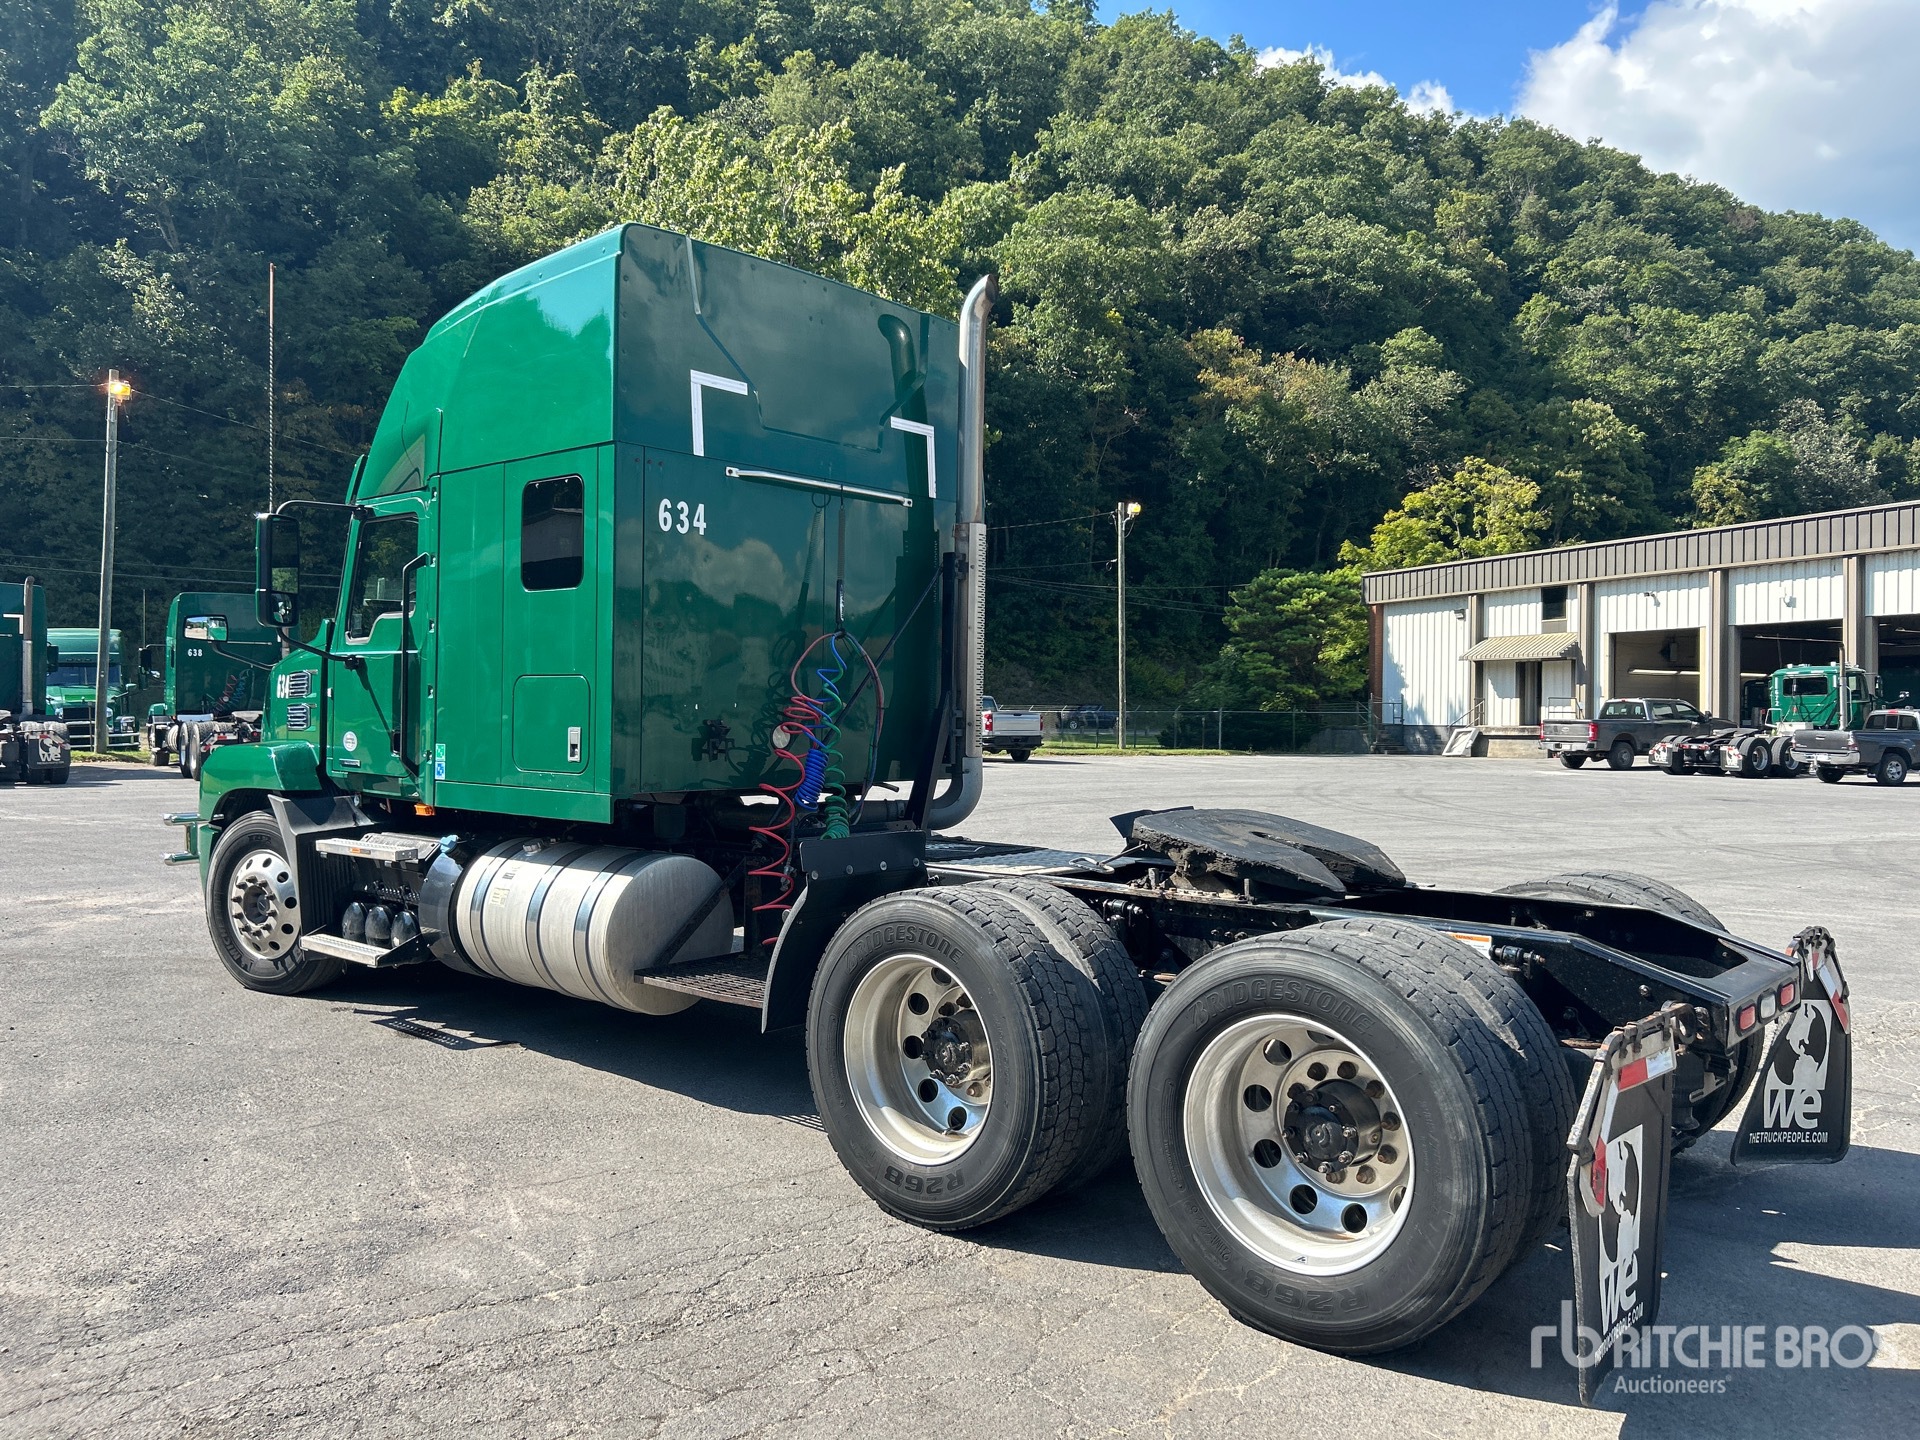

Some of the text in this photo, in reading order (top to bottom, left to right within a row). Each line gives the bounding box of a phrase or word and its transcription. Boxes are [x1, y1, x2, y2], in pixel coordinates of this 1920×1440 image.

[658, 498, 707, 536] 634
[187, 648, 203, 657] 638
[842, 924, 964, 976] BRIDGESTONE
[1187, 977, 1376, 1034] BRIDGESTONE
[1748, 1131, 1829, 1144] THETRUCKPEOPLE.COM
[884, 1166, 965, 1195] R268
[1243, 1269, 1368, 1314] R268
